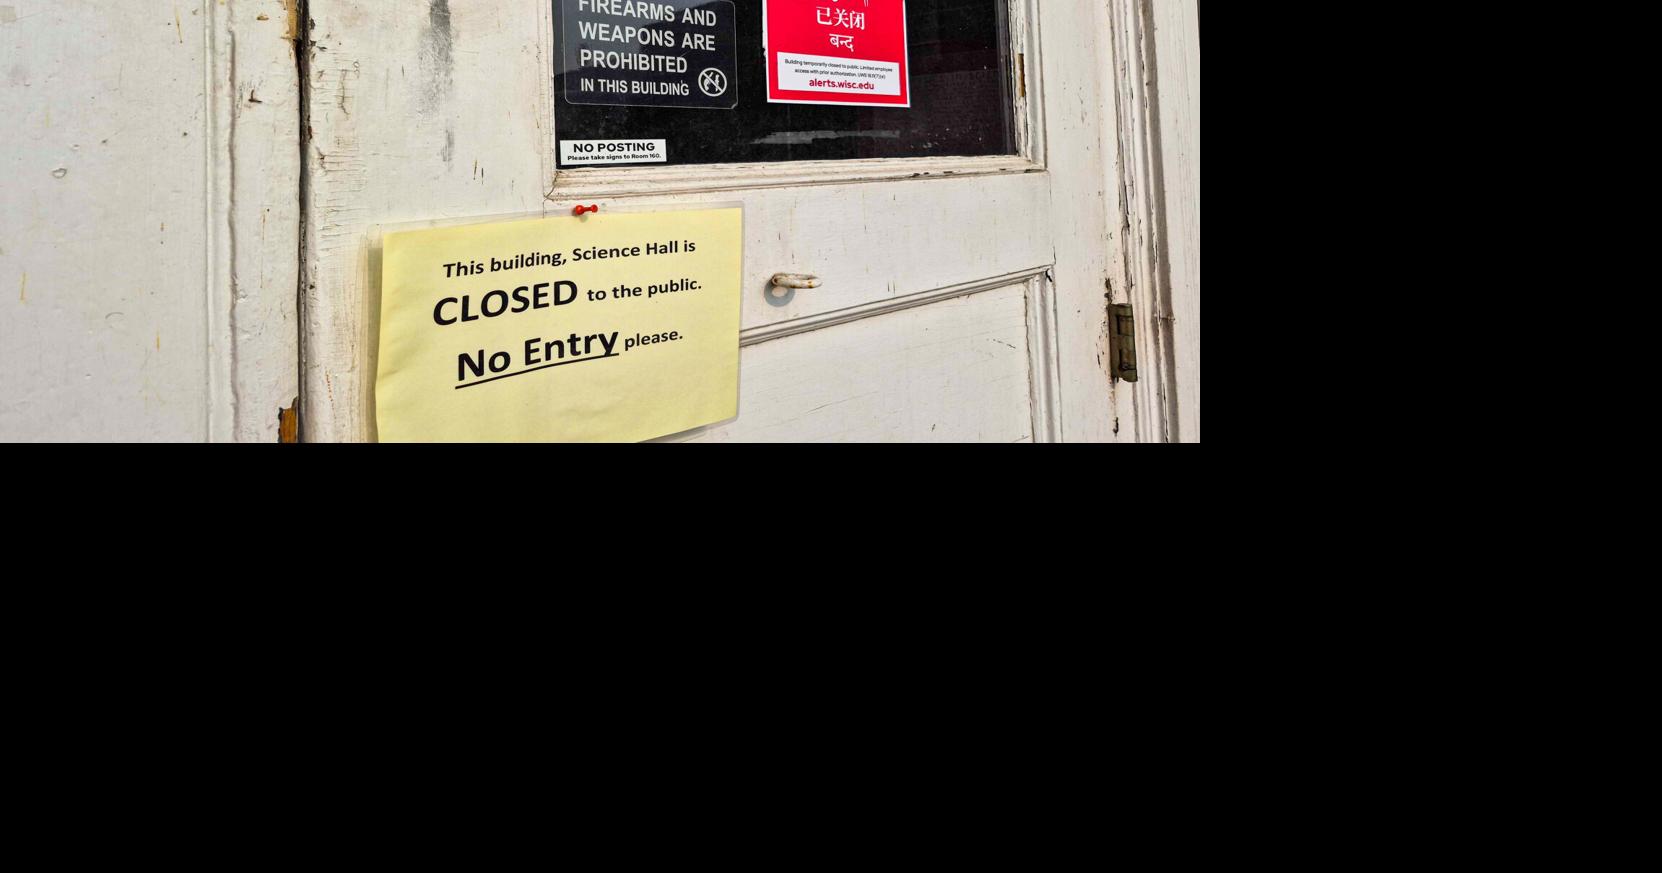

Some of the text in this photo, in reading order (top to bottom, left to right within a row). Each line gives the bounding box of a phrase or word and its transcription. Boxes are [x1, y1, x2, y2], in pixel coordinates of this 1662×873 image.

[579, 0, 717, 27] FIREARMS AND
[816, 6, 865, 30] 已关闭
[578, 21, 716, 51] WEAPONS ARE
[829, 33, 854, 52] बन्द
[580, 48, 688, 74] PROHIBITED
[784, 58, 803, 66] Building
[803, 60, 828, 68] temporarily
[580, 78, 690, 96] IN THIS BUILDING
[809, 78, 875, 90] alerts.wisc.edu
[573, 142, 656, 153] NO POSTING
[443, 239, 697, 279] This building, Science Hall is
[433, 277, 702, 327] CLOSED to the public.
[457, 329, 684, 382] No Entry please.
